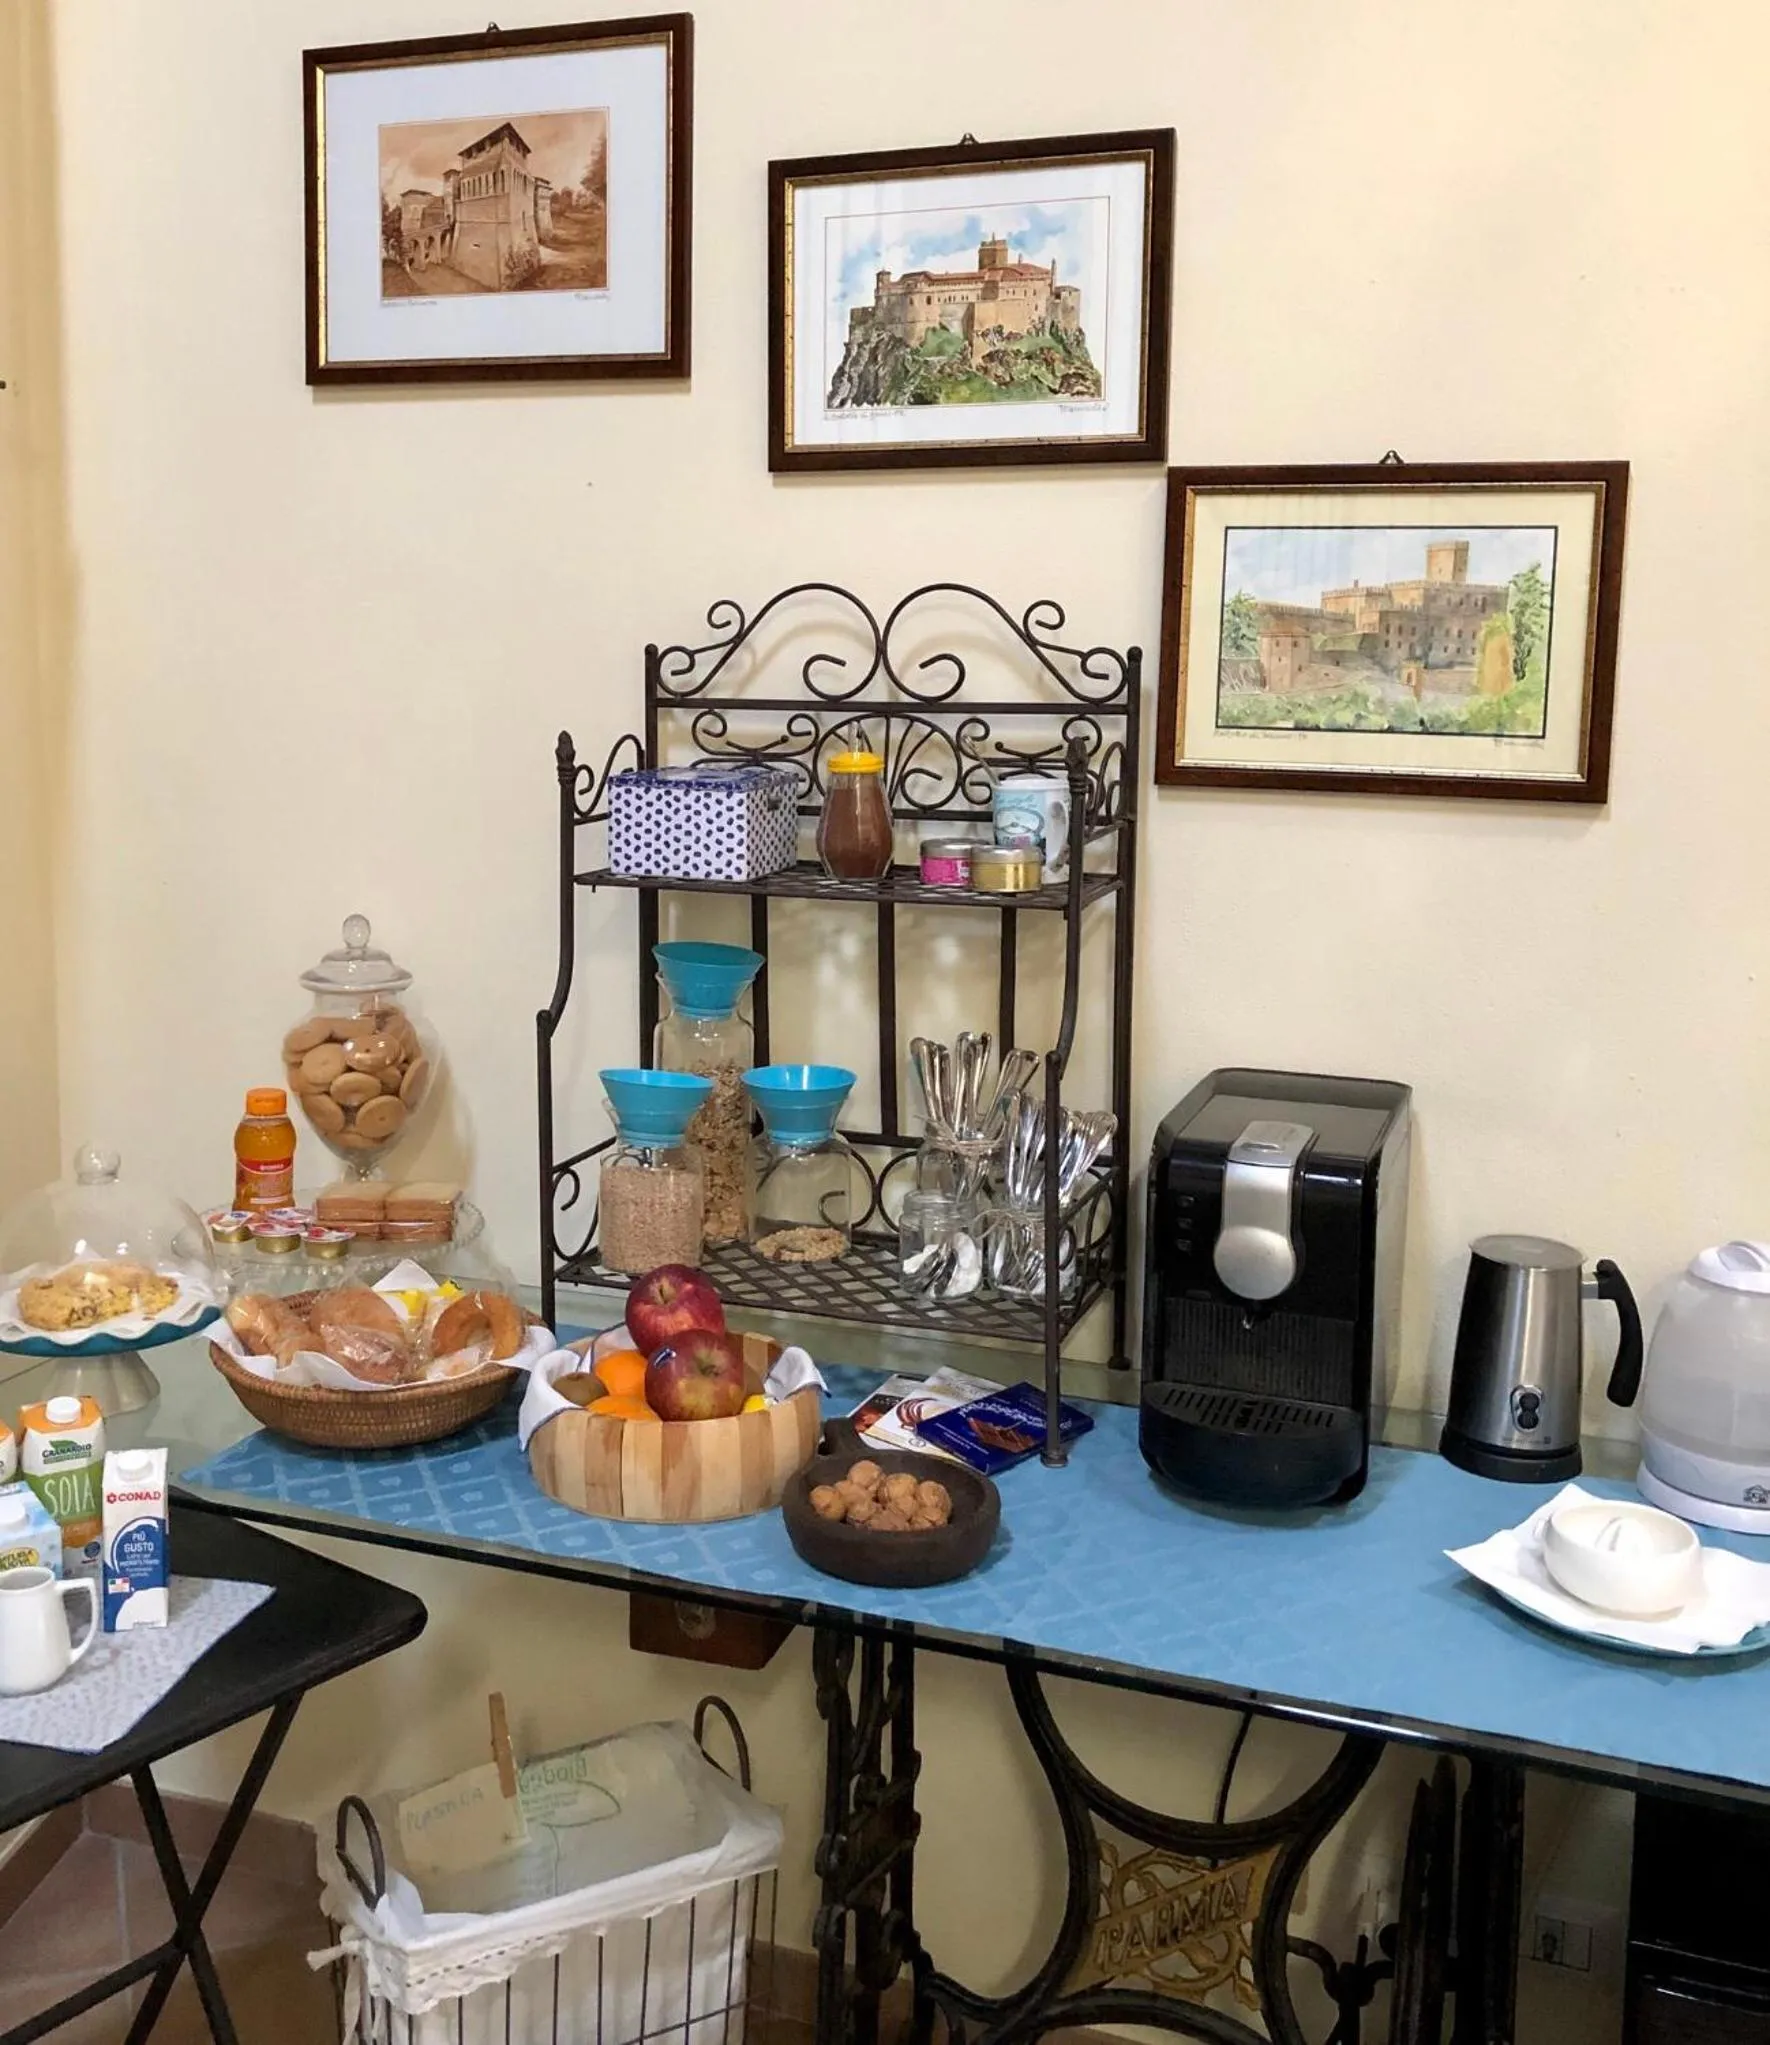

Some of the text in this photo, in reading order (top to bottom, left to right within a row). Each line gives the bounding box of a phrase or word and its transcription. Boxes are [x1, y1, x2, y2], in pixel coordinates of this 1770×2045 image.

[44, 1473, 96, 1516] SOIA
[118, 1491, 162, 1502] CONAD
[123, 1541, 155, 1553] GUSTO
[1094, 1872, 1245, 1970] PARMA
